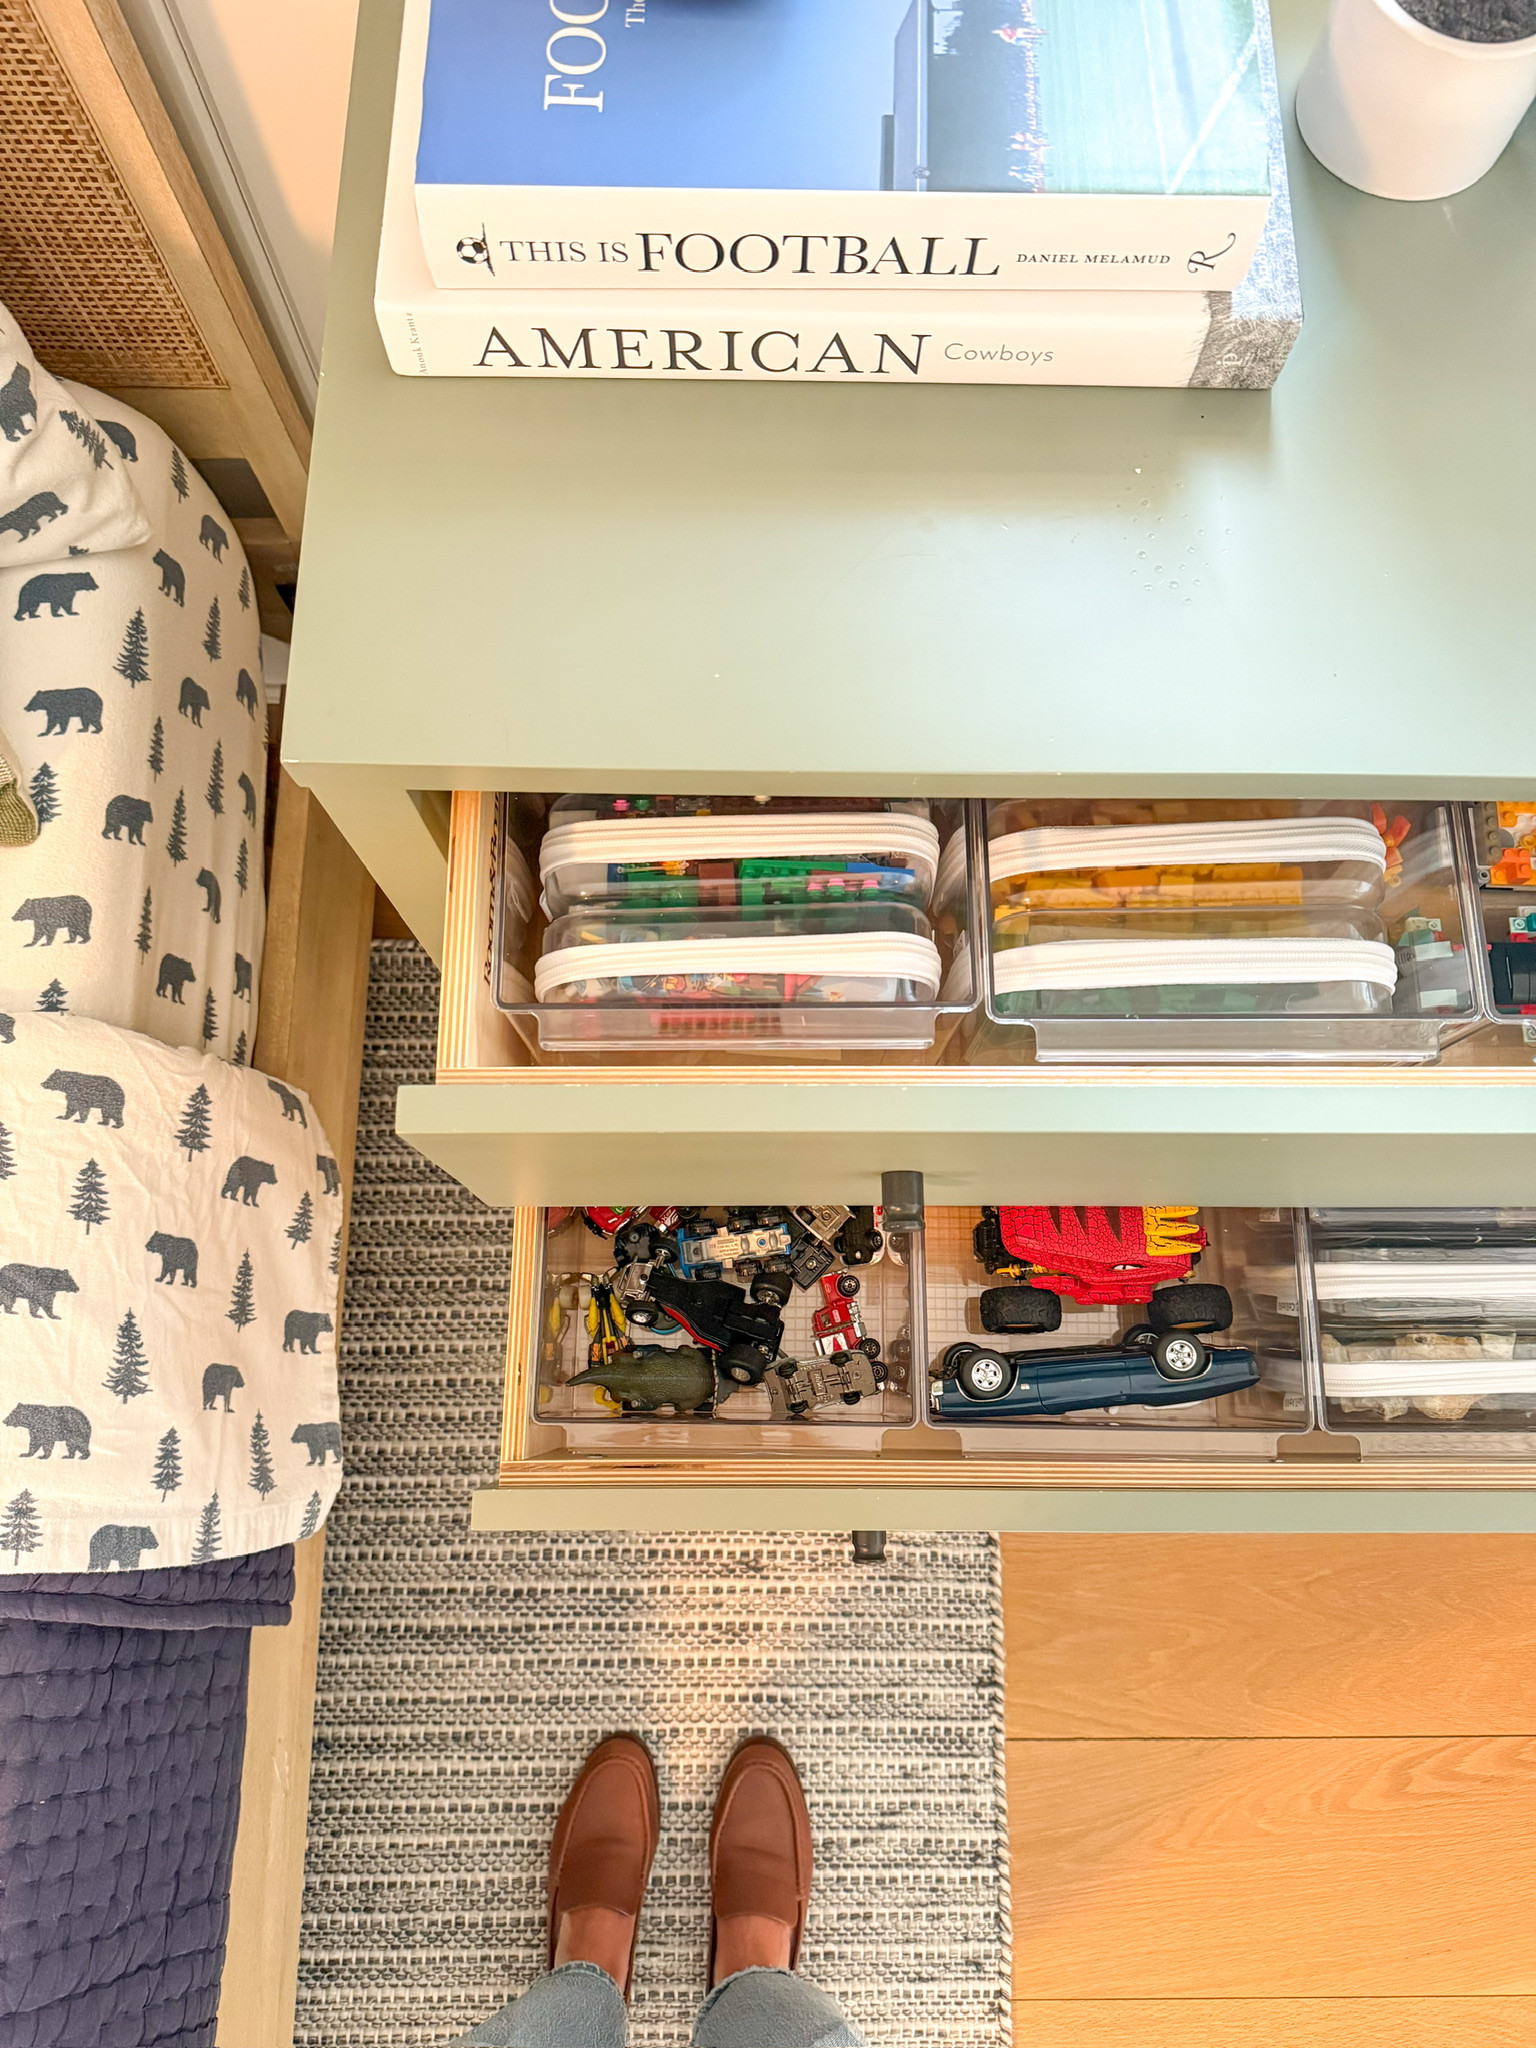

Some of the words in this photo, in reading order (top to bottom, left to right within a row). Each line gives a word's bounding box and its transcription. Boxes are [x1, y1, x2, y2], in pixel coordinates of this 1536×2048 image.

[499, 240, 587, 263] THIS
[598, 241, 629, 263] IS
[635, 232, 1000, 276] FOOTBALL
[1016, 253, 1079, 264] DANIEL
[1084, 253, 1171, 265] MELAMUD
[406, 311, 420, 345] Krantz
[412, 346, 429, 375] Anouk
[472, 326, 932, 376] AMERICAN
[944, 342, 1054, 366] Cowboys
